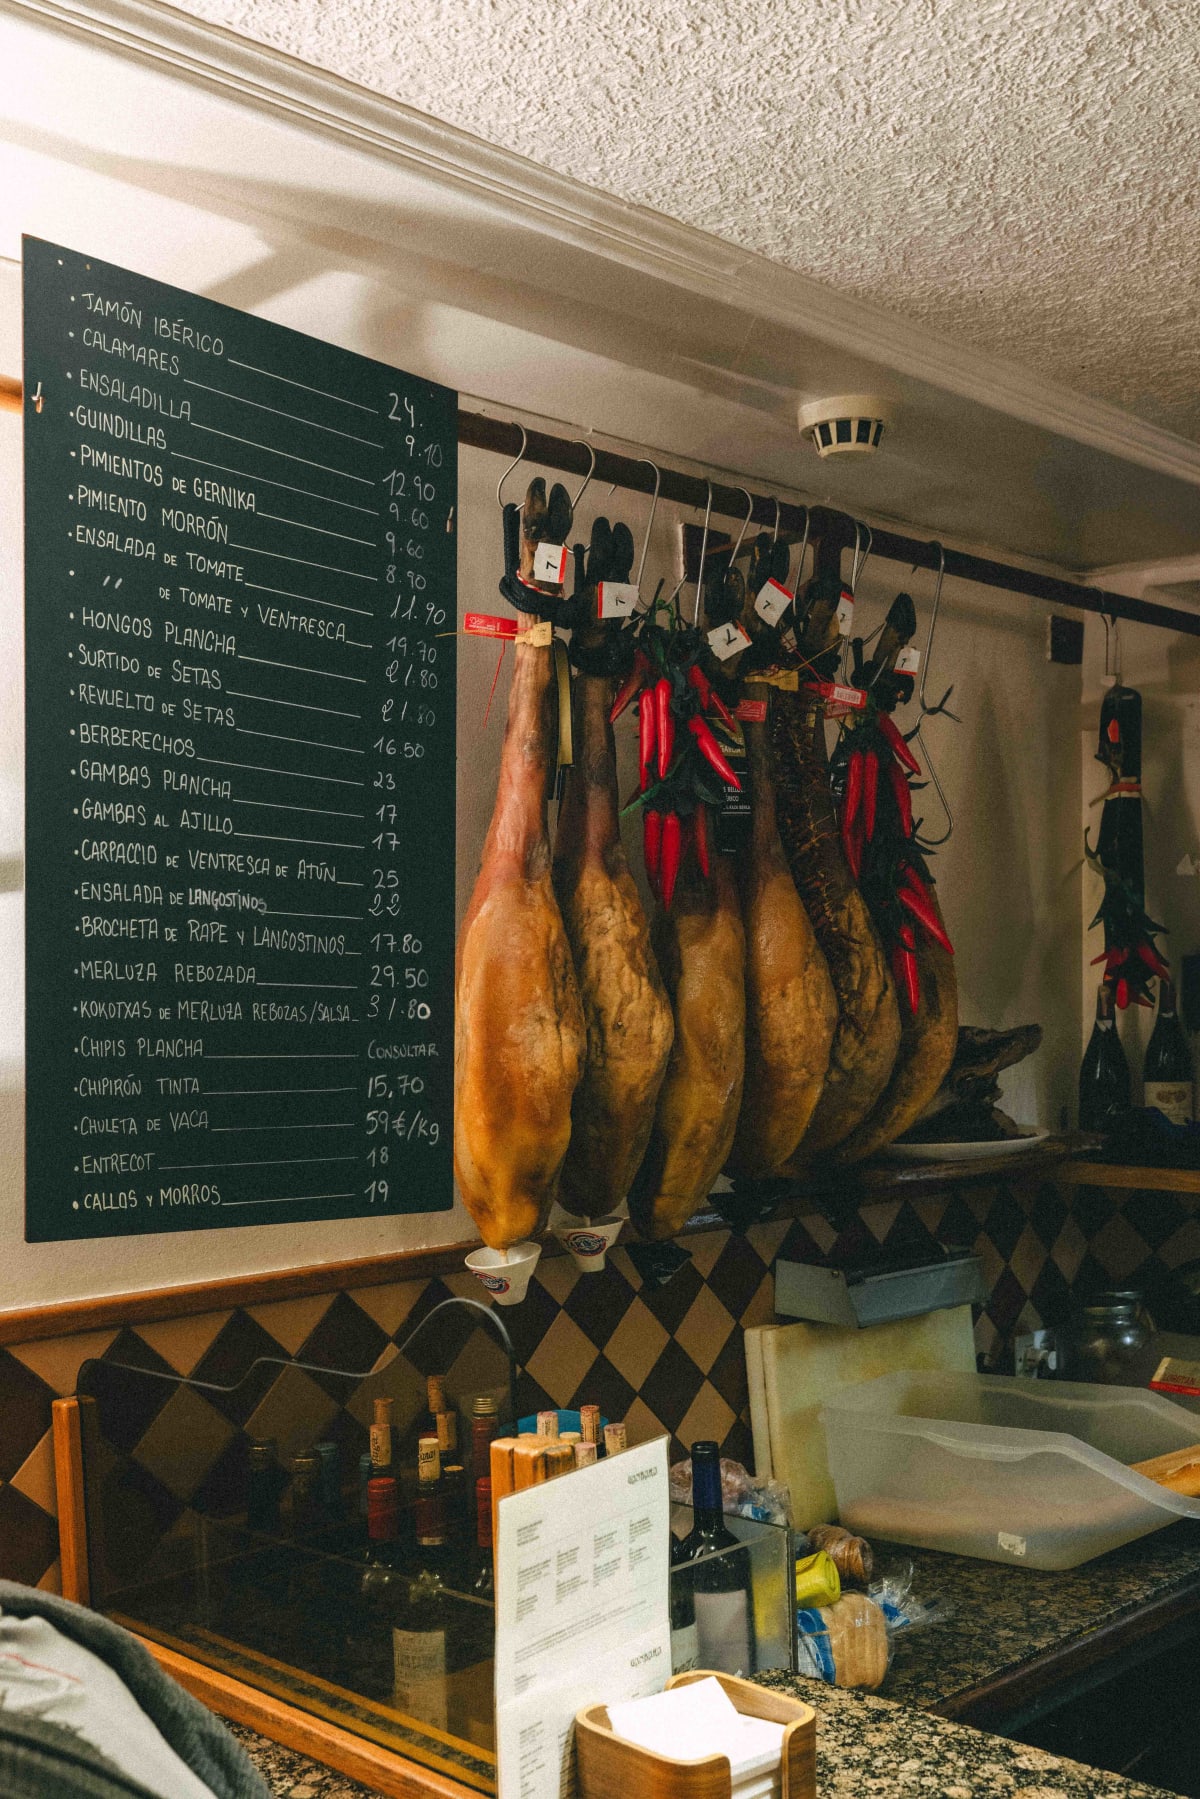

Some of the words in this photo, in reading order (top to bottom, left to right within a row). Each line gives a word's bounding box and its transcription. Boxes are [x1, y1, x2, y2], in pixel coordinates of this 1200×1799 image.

[155, 317, 223, 355] IBÉRICO
[83, 328, 179, 375] CALAMARES
[405, 435, 442, 467] 9.10
[80, 368, 191, 421] ENSALADILLA
[382, 470, 435, 501] 12.90
[76, 405, 166, 449] GUINDILLAS
[389, 502, 429, 530] 9.60
[81, 444, 163, 486] PIMIENTOS
[193, 478, 255, 512] GERNIKA
[386, 531, 424, 559] 9.60
[76, 525, 156, 560] ENSALADA
[186, 552, 244, 582] TOMATE
[78, 485, 146, 521] PIMIENTO
[162, 508, 228, 545] MORRÓN
[386, 564, 426, 590] 8.90
[82, 607, 152, 639] HONGOS
[164, 622, 236, 656] PLANCHA
[179, 587, 233, 614] TOMATE
[258, 603, 346, 642] VENTRESCA
[386, 636, 437, 663] 19.70
[78, 644, 140, 674] SURTIDO
[171, 660, 222, 690] SETAS
[79, 683, 155, 712] REVUELTO
[183, 699, 236, 727] SETAS
[79, 723, 196, 758] BERBERECHOS
[373, 771, 396, 790] 23
[79, 759, 151, 789] GAMBAS
[163, 769, 231, 799] PLANCHA
[375, 804, 398, 825] 17
[81, 798, 147, 826] GAMBAS
[180, 809, 233, 835] AJILLO
[372, 832, 401, 851] 17
[81, 839, 157, 865] CARPACCIO
[188, 850, 270, 876] VENTRESCA
[297, 859, 336, 883] ATÚN
[372, 868, 399, 889] 25
[81, 882, 163, 906] ENSALADA
[368, 893, 400, 916] 22
[81, 915, 158, 939] BROCHETA
[188, 920, 229, 943] RAPE
[253, 926, 345, 955] LANGOSTINOS
[370, 933, 423, 954] 17.80
[81, 961, 157, 981] MERLUZA
[175, 963, 256, 984] REBOZADA
[370, 965, 429, 989] 29.50
[80, 1000, 151, 1020] KOKOTXAS
[177, 1001, 243, 1021] MERLUZA
[80, 1036, 126, 1058] CHIPIS
[137, 1038, 203, 1058] PLANCHA
[368, 1039, 439, 1059] CONSULTAR
[79, 1073, 142, 1097] CHIPIRÓN
[156, 1078, 200, 1095] TINTA
[80, 1116, 138, 1136] CHULETA
[169, 1110, 209, 1131] VACA
[82, 1153, 155, 1174] ENTRECOT
[366, 1146, 389, 1168] 18
[84, 1189, 138, 1211] CALLOS
[160, 1183, 221, 1206] MORROS
[364, 1180, 389, 1203] 19
